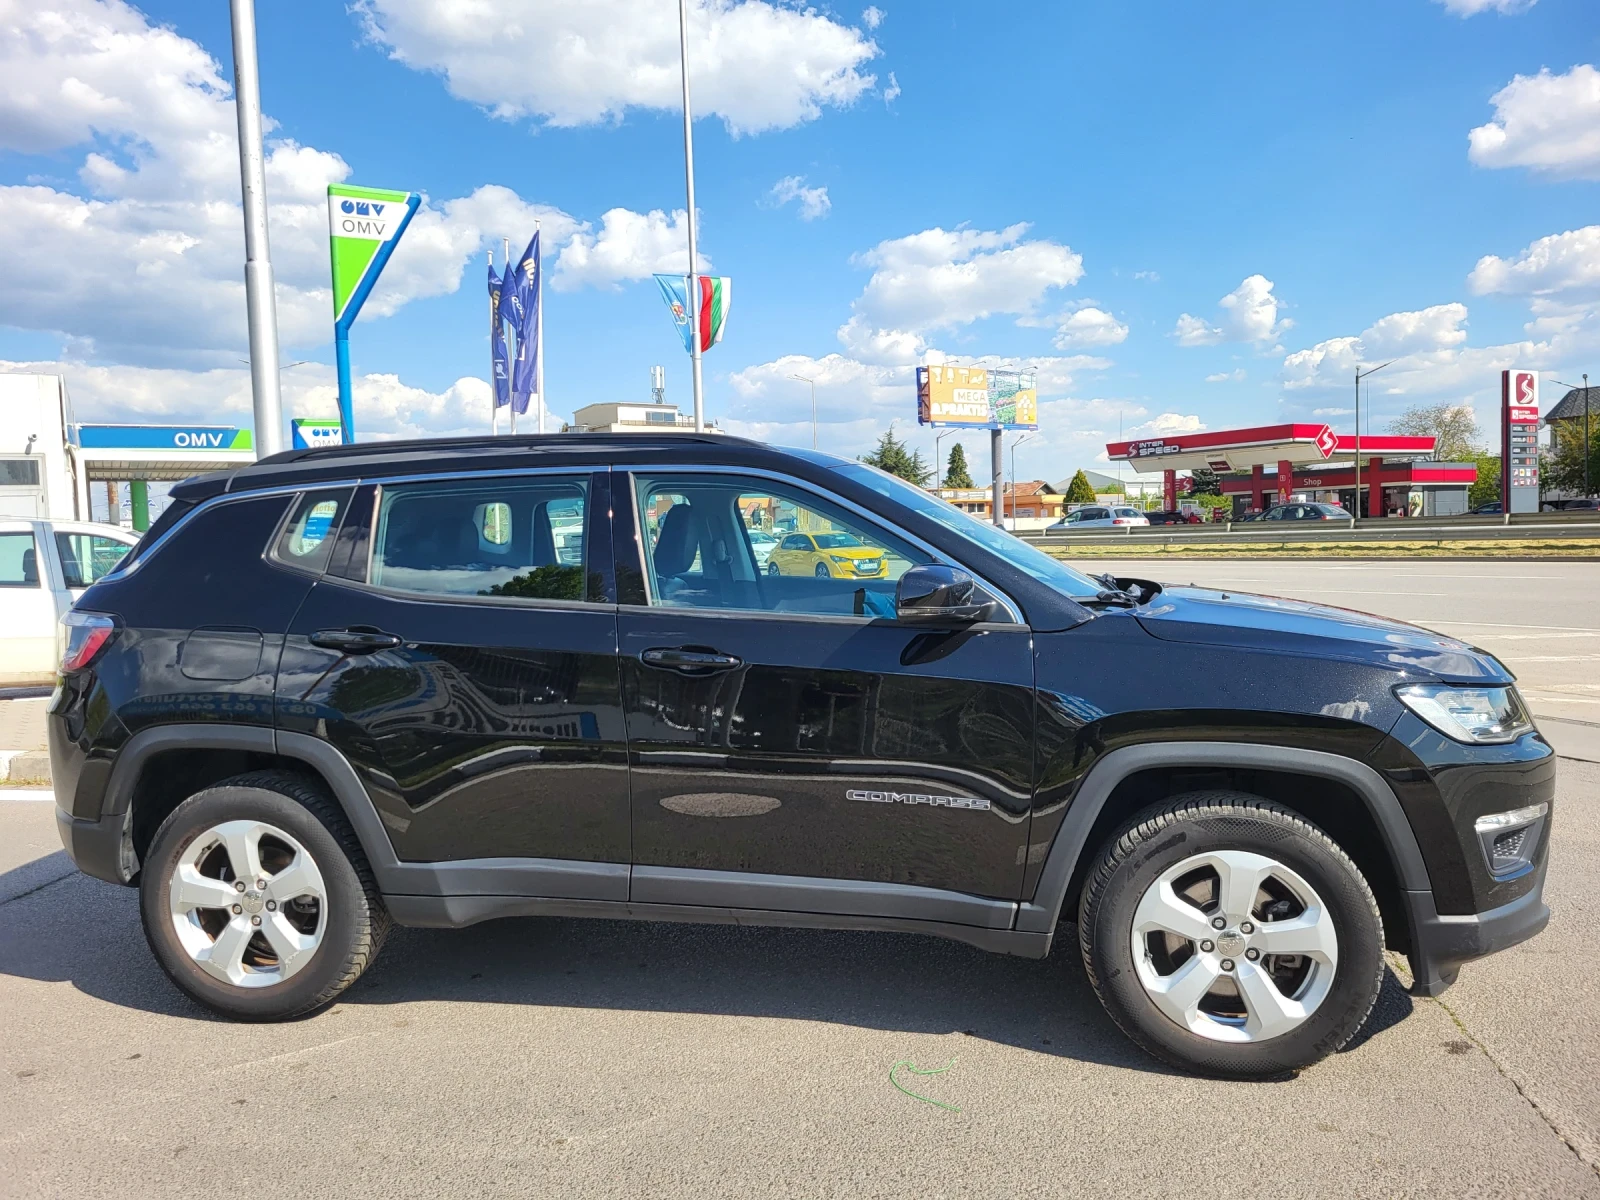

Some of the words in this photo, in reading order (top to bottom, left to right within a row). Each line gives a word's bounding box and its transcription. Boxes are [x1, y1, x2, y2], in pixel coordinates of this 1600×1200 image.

[342, 219, 386, 235] OMV
[957, 391, 986, 402] MEGA
[174, 432, 223, 447] OMV
[1139, 440, 1164, 448] INTER
[1139, 445, 1180, 456] SPEED
[1303, 478, 1322, 486] Shop
[846, 789, 991, 811] COMPASS
